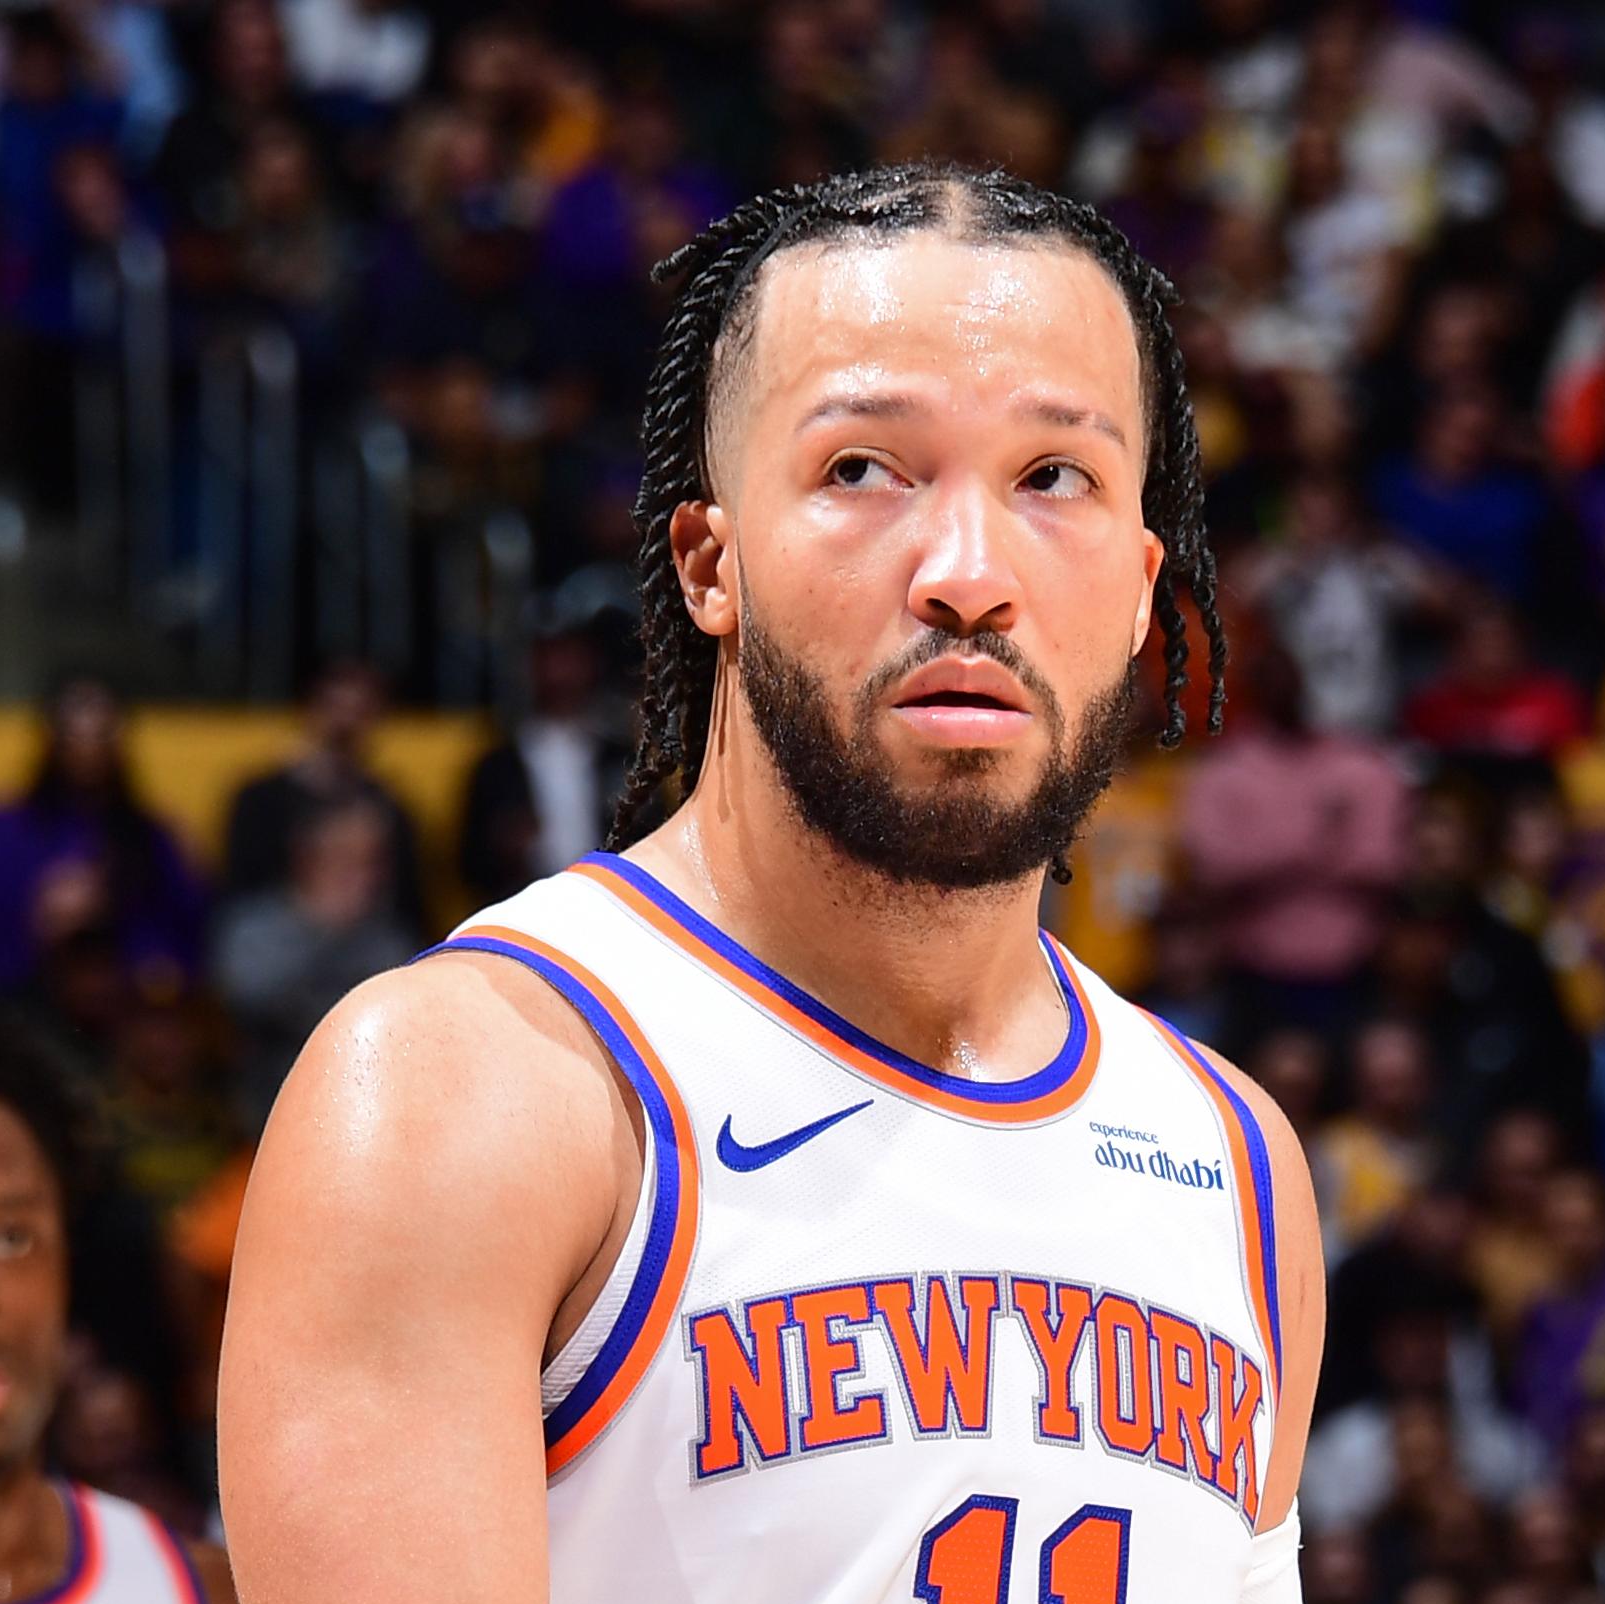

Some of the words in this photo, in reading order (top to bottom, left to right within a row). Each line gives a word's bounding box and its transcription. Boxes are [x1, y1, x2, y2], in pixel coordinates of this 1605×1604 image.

[1089, 1121, 1160, 1145] experience
[1095, 1140, 1146, 1175] abu
[1148, 1150, 1225, 1191] dhabi
[684, 1271, 1002, 1486] NEW
[1007, 1271, 1264, 1536] YORK
